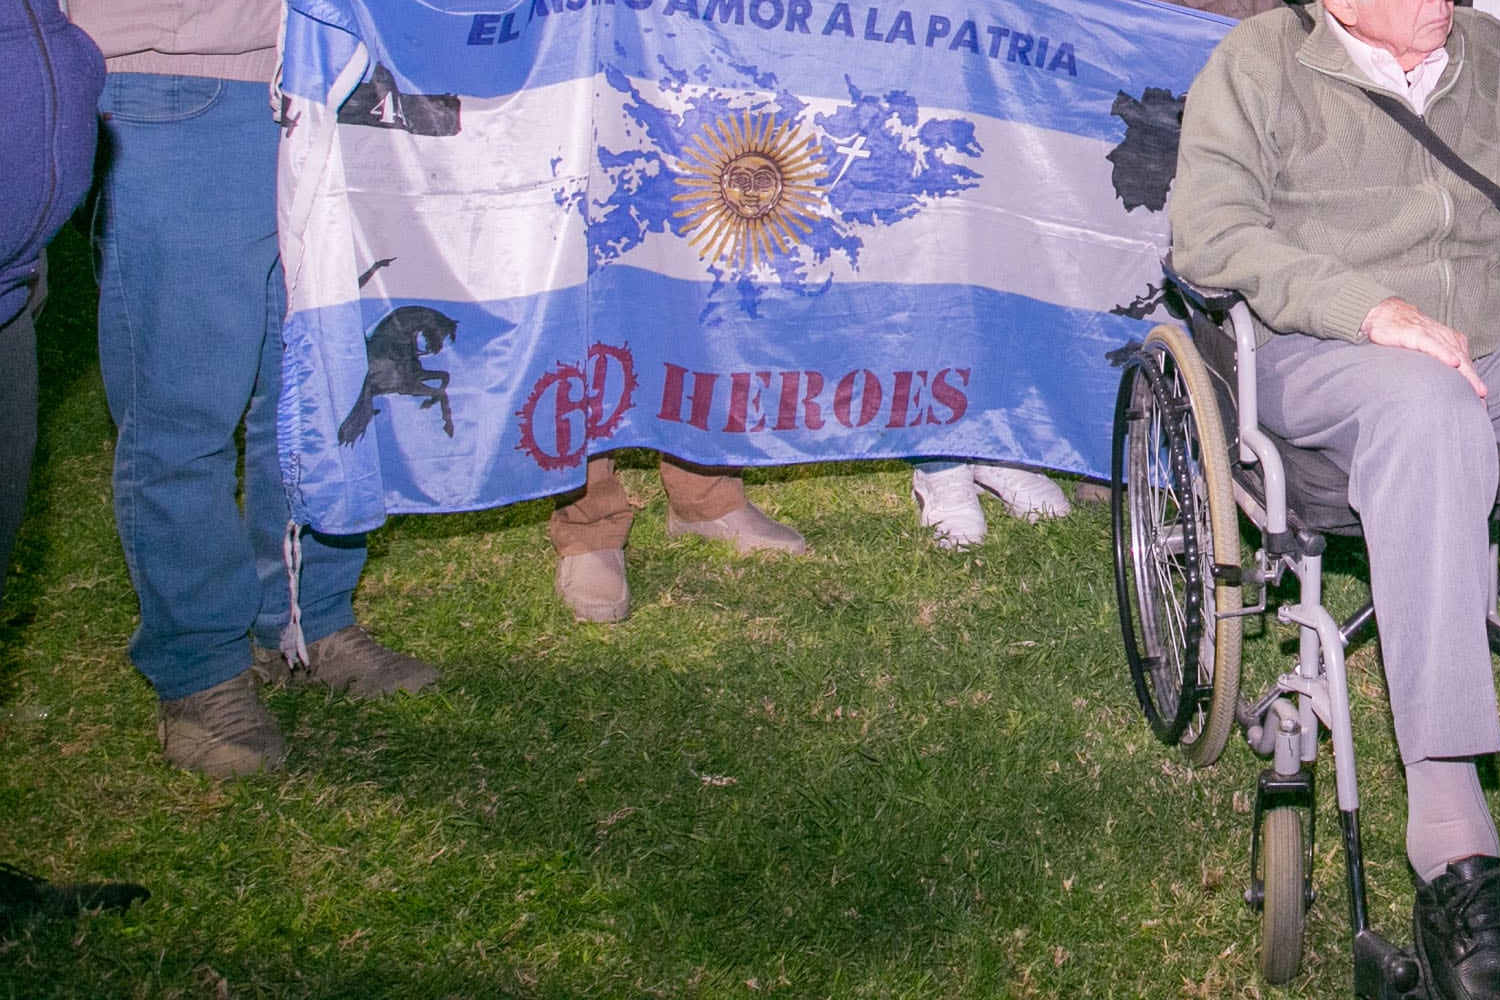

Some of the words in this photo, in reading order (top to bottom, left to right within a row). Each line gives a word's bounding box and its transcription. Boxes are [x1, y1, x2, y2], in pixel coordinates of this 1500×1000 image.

[467, 13, 521, 46] EL
[822, 2, 855, 38] A
[863, 9, 917, 46] LA
[925, 14, 1078, 77] PATRIA
[656, 360, 972, 434] HEROES
